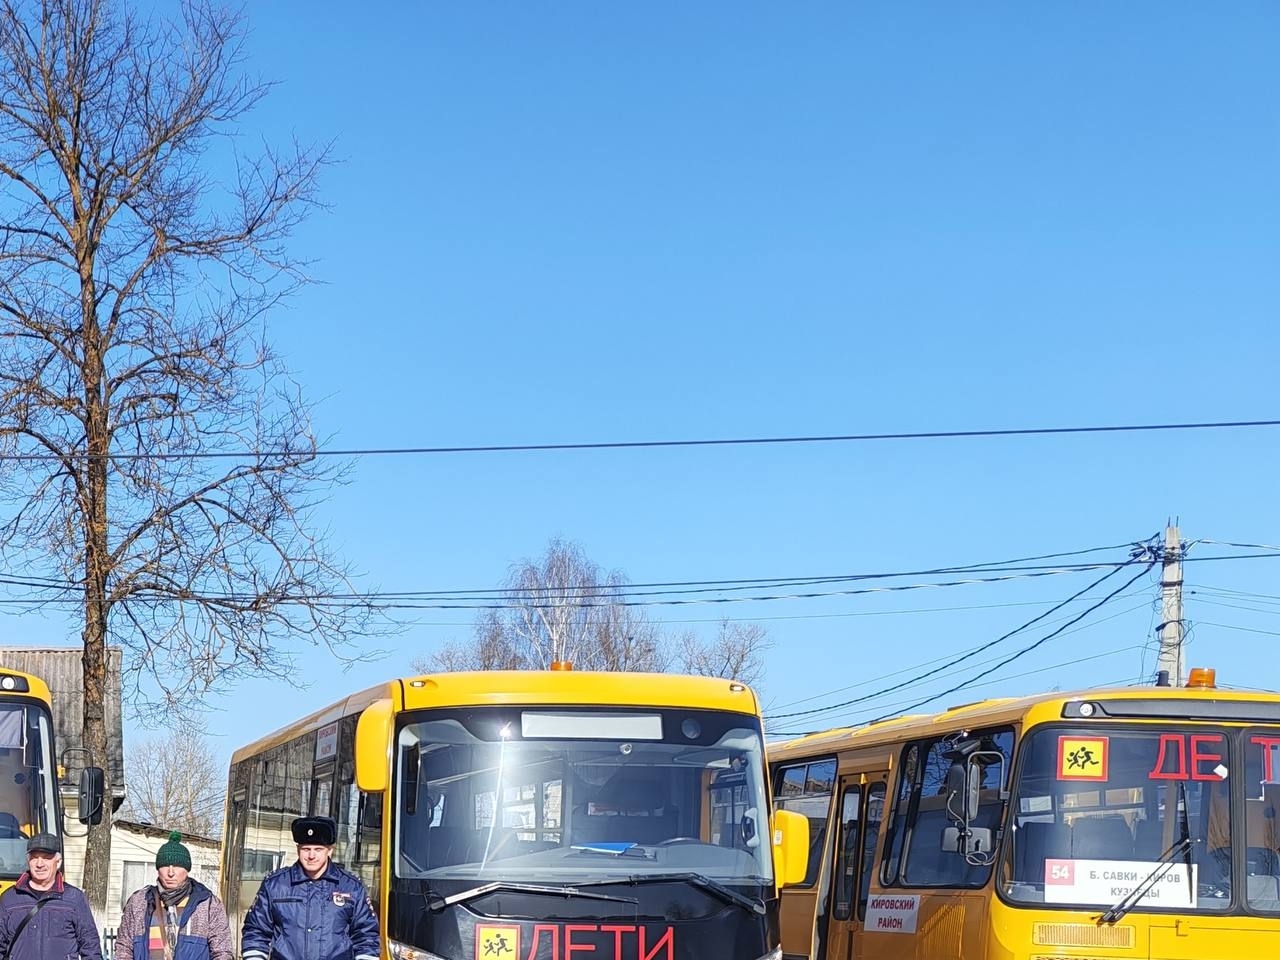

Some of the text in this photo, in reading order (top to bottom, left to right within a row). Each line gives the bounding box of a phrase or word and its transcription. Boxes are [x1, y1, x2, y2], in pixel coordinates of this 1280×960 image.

[1051, 865, 1069, 879] 54
[1103, 871, 1138, 881] САВКИ
[871, 897, 915, 910] КИРОВСКИЙ
[877, 915, 903, 929] РАЙОН
